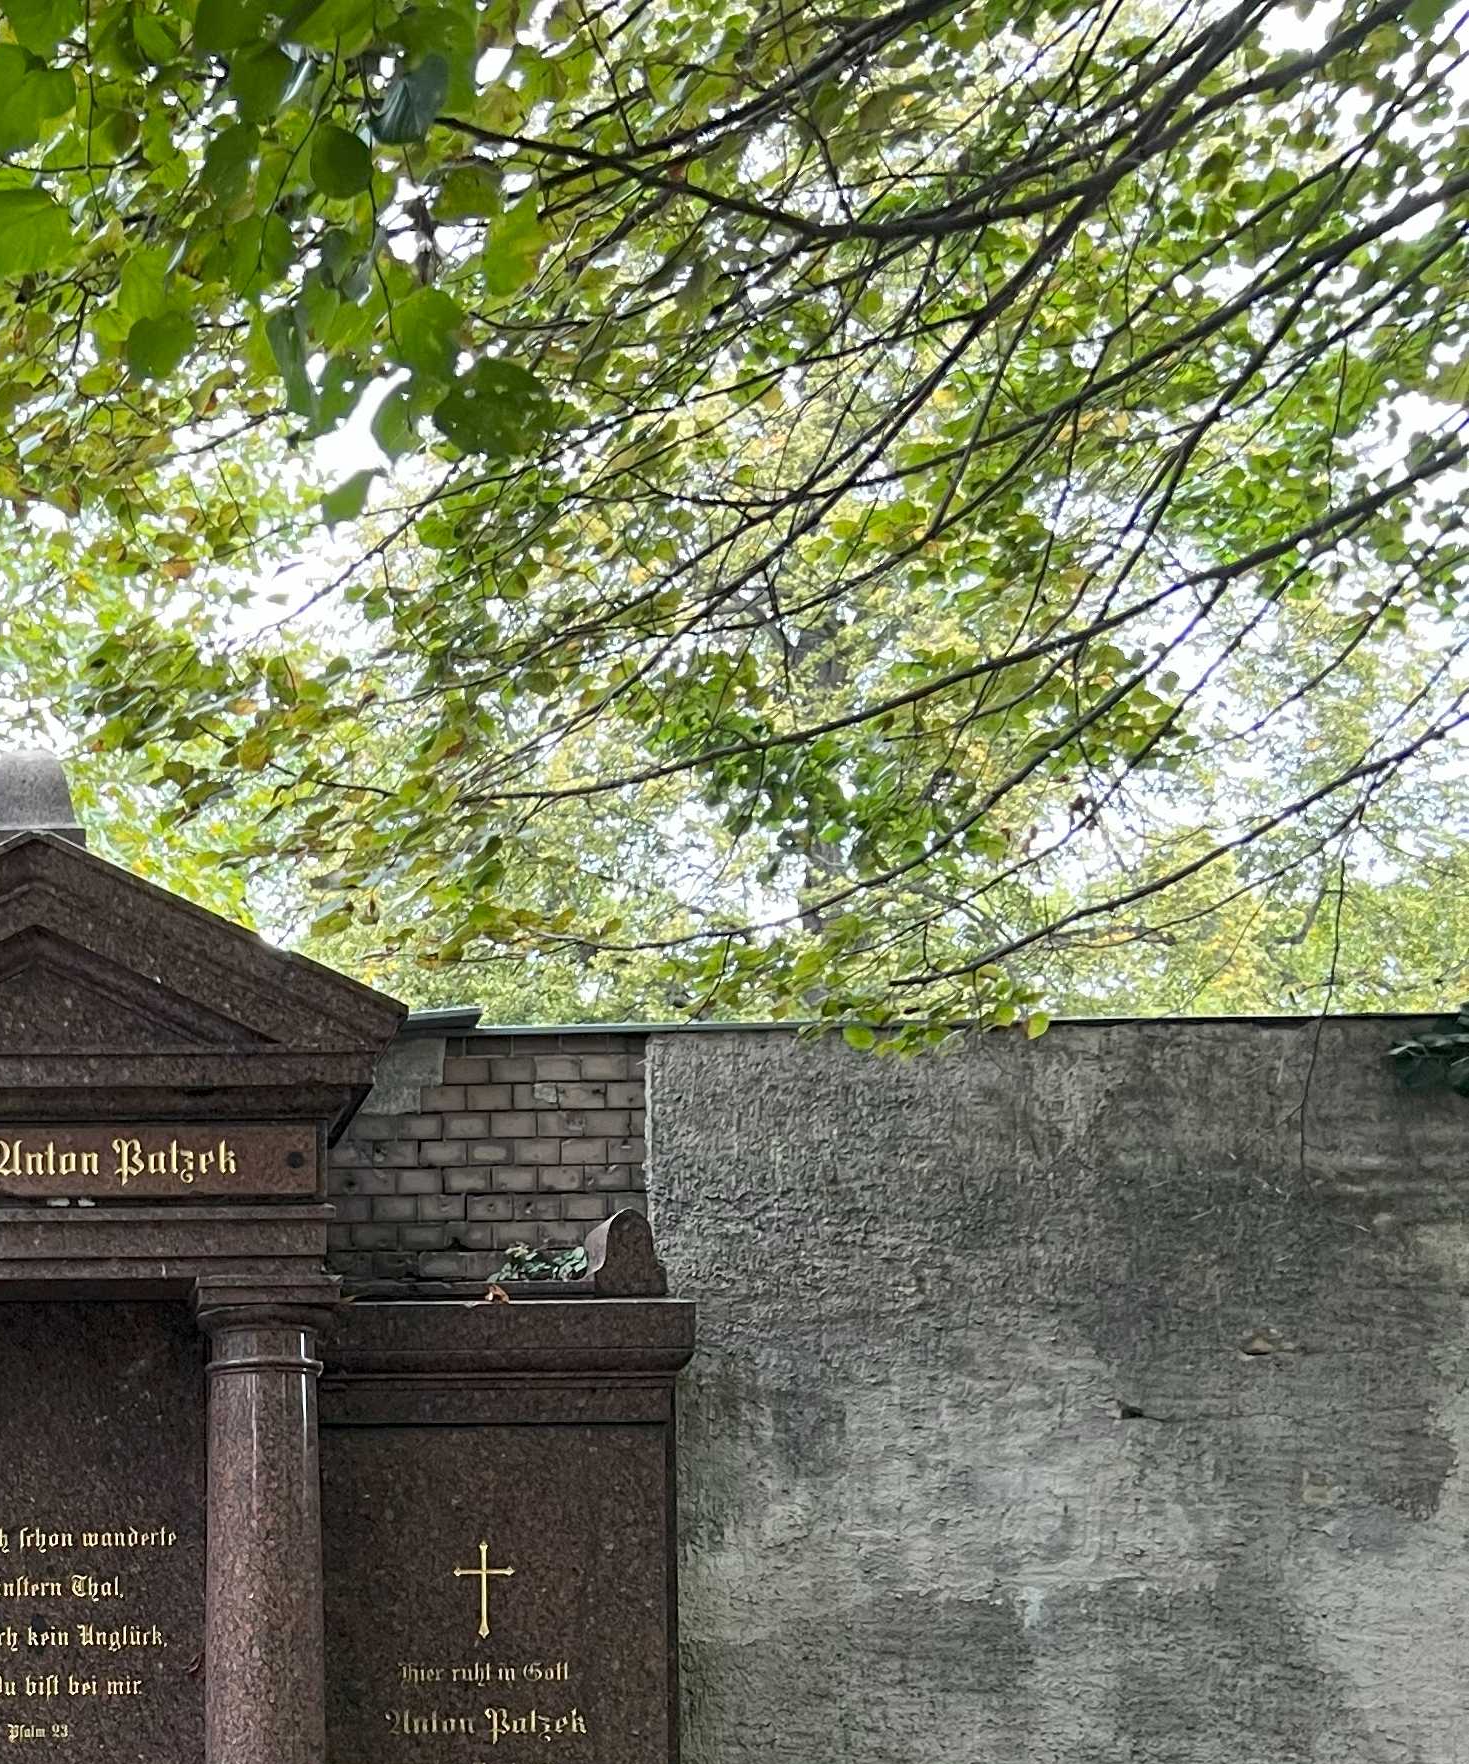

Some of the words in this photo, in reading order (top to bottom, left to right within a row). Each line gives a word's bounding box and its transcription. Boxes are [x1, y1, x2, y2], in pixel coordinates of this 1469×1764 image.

[112, 1139, 237, 1187] Patzek
[82, 1526, 177, 1548] wanderte
[27, 1626, 69, 1646] kein
[68, 1675, 97, 1696] bei
[107, 1675, 143, 1696] mir.
[397, 1662, 445, 1690] Hier
[451, 1662, 491, 1687] ruht
[497, 1663, 516, 1682] in
[523, 1661, 569, 1682] Gott
[385, 1708, 475, 1735] Anton
[484, 1705, 587, 1745] Patzek
